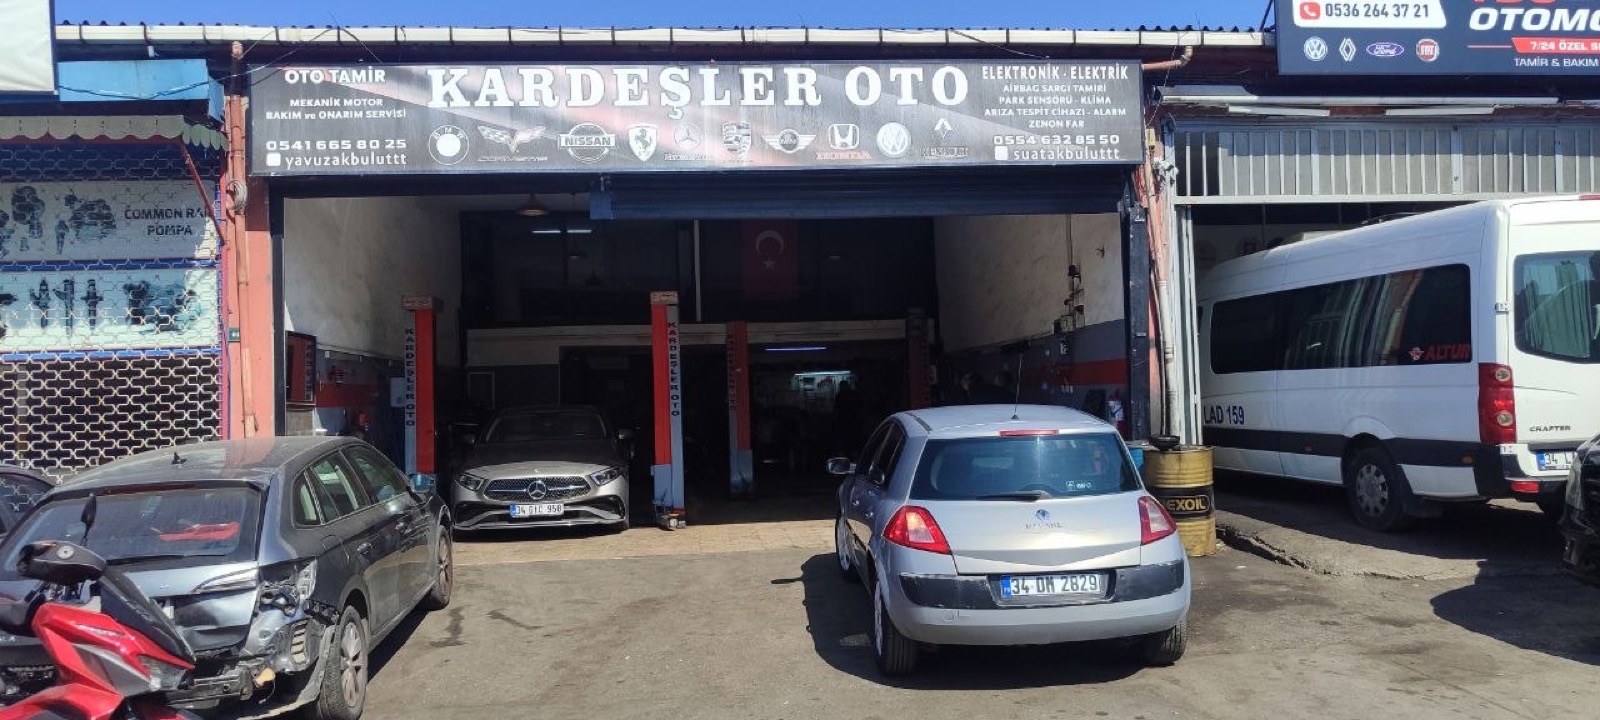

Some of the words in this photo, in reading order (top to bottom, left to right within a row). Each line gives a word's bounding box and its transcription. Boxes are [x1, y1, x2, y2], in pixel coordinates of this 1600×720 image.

[1325, 3, 1360, 17] 0536
[1363, 3, 1389, 17] 264
[1393, 4, 1410, 17] 37
[1413, 4, 1429, 17] 21
[1529, 41, 1556, 51] 7/24
[1558, 39, 1589, 51] ÖZEL
[1551, 58, 1561, 67] &
[1563, 58, 1599, 67] BAKIM
[284, 69, 325, 85] OTO
[328, 66, 386, 84] TAMİR
[981, 63, 1060, 80] ELEKTRONİK
[1070, 62, 1129, 80] ELEKTRİK
[427, 67, 822, 120] KARDEŞLER
[844, 65, 969, 106] OTO
[1041, 84, 1071, 93] SARGI
[289, 97, 341, 107] MEKANİK
[343, 98, 384, 107] MOTOR
[999, 96, 1025, 105] PARK
[1027, 94, 1073, 105] SENSÖRÜ
[1080, 95, 1112, 104] KLİMA
[265, 111, 302, 120] BAKIM
[318, 110, 363, 119] ONARIM
[365, 107, 407, 119] SERVİSİ
[984, 108, 1015, 117] ARIZA
[1017, 107, 1049, 116] TESPİT
[1051, 107, 1085, 116] CİHAZI
[1093, 108, 1126, 116] ALARM
[1028, 120, 1064, 129] ZENON
[1066, 120, 1085, 128] FAR
[265, 140, 311, 150] 0541
[315, 140, 352, 150] 665
[356, 139, 380, 150] 80
[384, 139, 407, 149] 25
[565, 136, 611, 146] NISSAN
[993, 135, 1037, 145] 0554
[1041, 135, 1072, 145] 632
[1075, 135, 1096, 145] 85
[1099, 134, 1120, 145] 50
[1013, 145, 1120, 161] suatakbuluttt
[285, 151, 407, 170] yavuzakbuluttt
[124, 208, 183, 220] COMMON
[147, 224, 193, 236] POMPA
[1424, 344, 1470, 361] ALTUR
[671, 394, 680, 417] OTO
[405, 403, 416, 427] OTO
[1226, 404, 1245, 425] 159
[1545, 452, 1558, 465] 34
[1010, 578, 1030, 595] 34
[1036, 576, 1056, 593] DM
[1060, 574, 1098, 592] 2829
